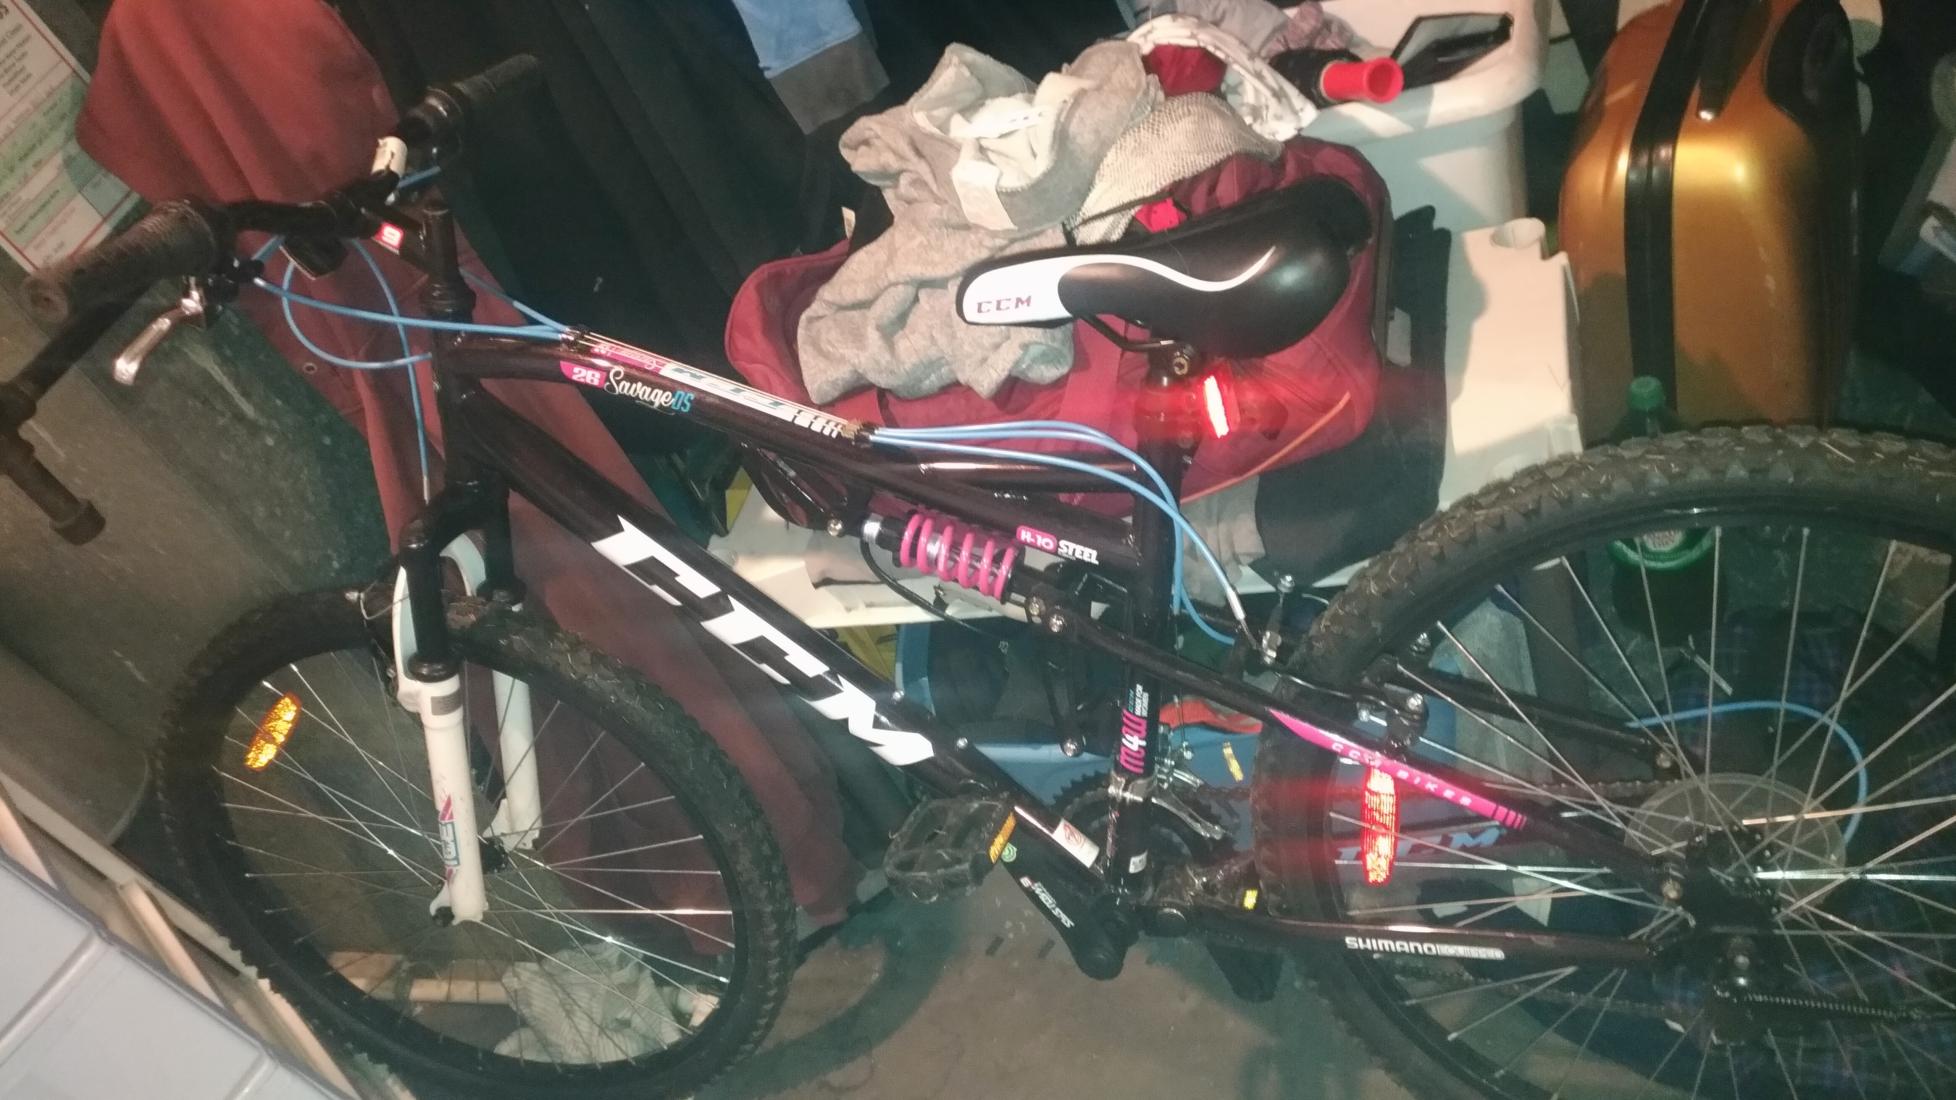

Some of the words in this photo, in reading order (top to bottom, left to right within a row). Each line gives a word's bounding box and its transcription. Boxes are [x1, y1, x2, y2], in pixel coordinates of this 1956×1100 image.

[977, 295, 1032, 314] CCM
[571, 366, 602, 386] 26
[1020, 528, 1056, 551] H-10
[1058, 539, 1100, 566] STEEL
[591, 514, 935, 767] CCM
[1395, 770, 1473, 806] BIKES
[1344, 936, 1438, 955] SHIMANO
